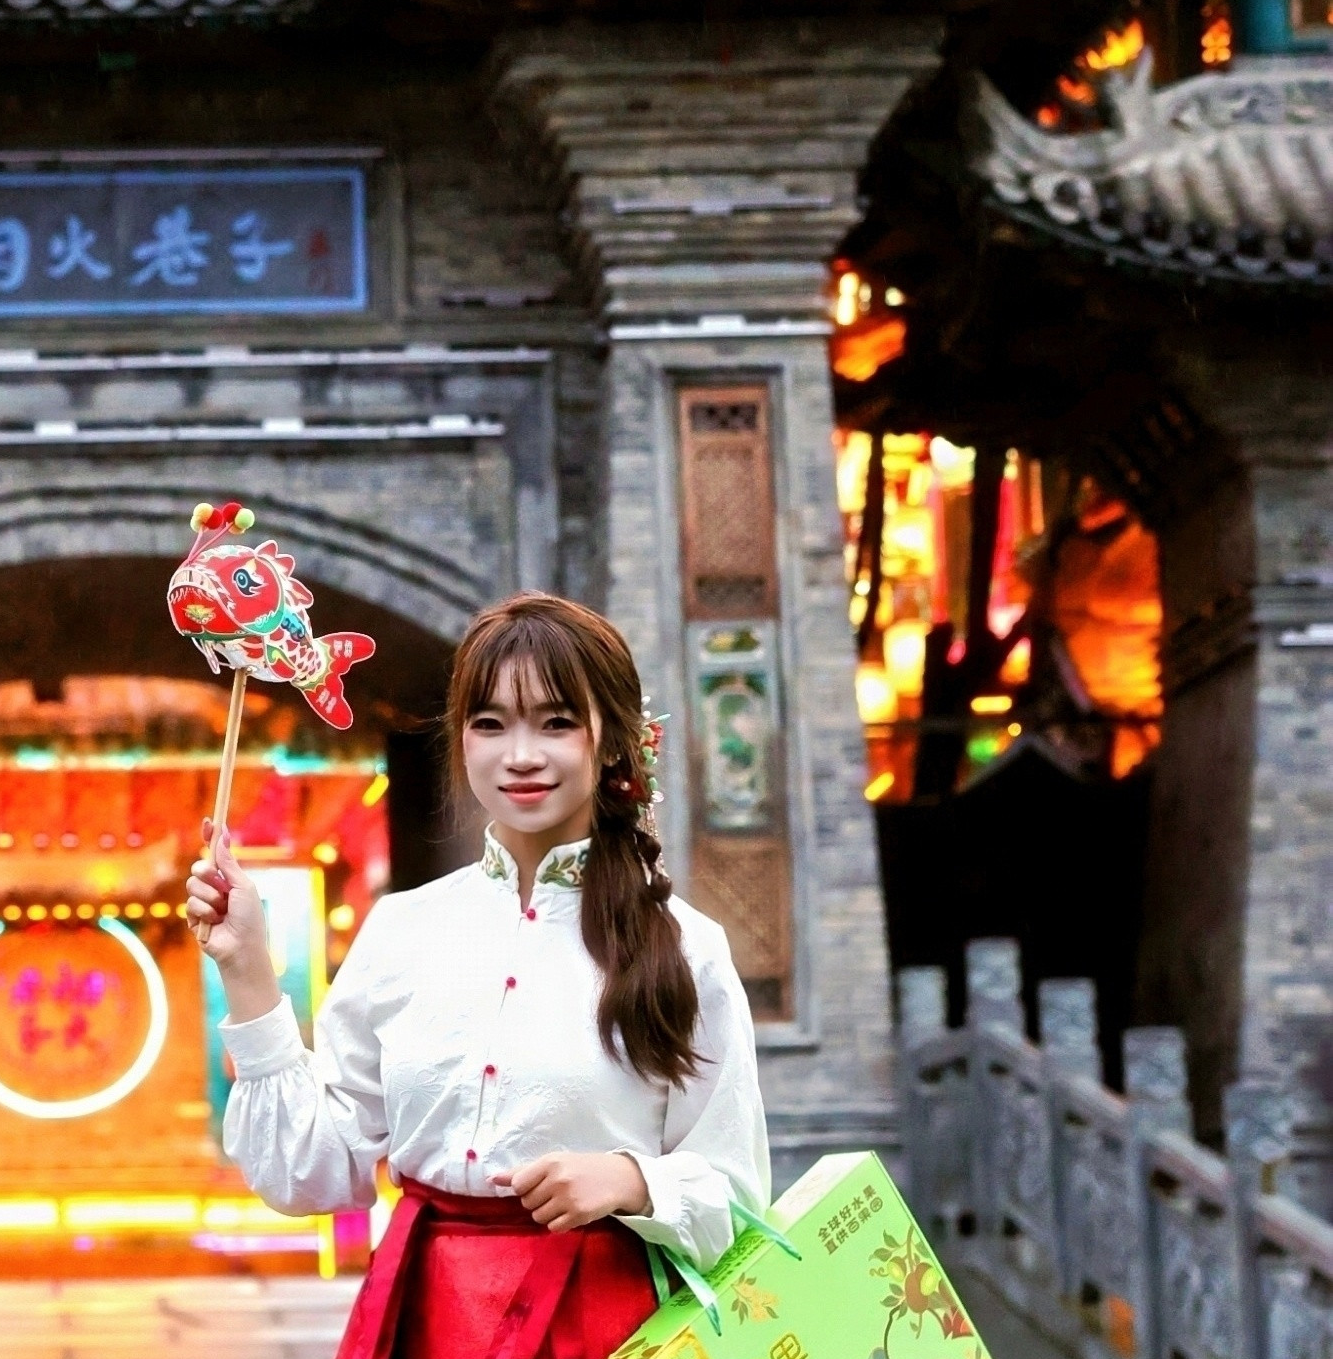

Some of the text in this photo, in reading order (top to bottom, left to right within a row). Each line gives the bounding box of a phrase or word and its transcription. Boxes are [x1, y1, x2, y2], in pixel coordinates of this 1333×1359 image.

[818, 1185, 876, 1242] 全球好水果
